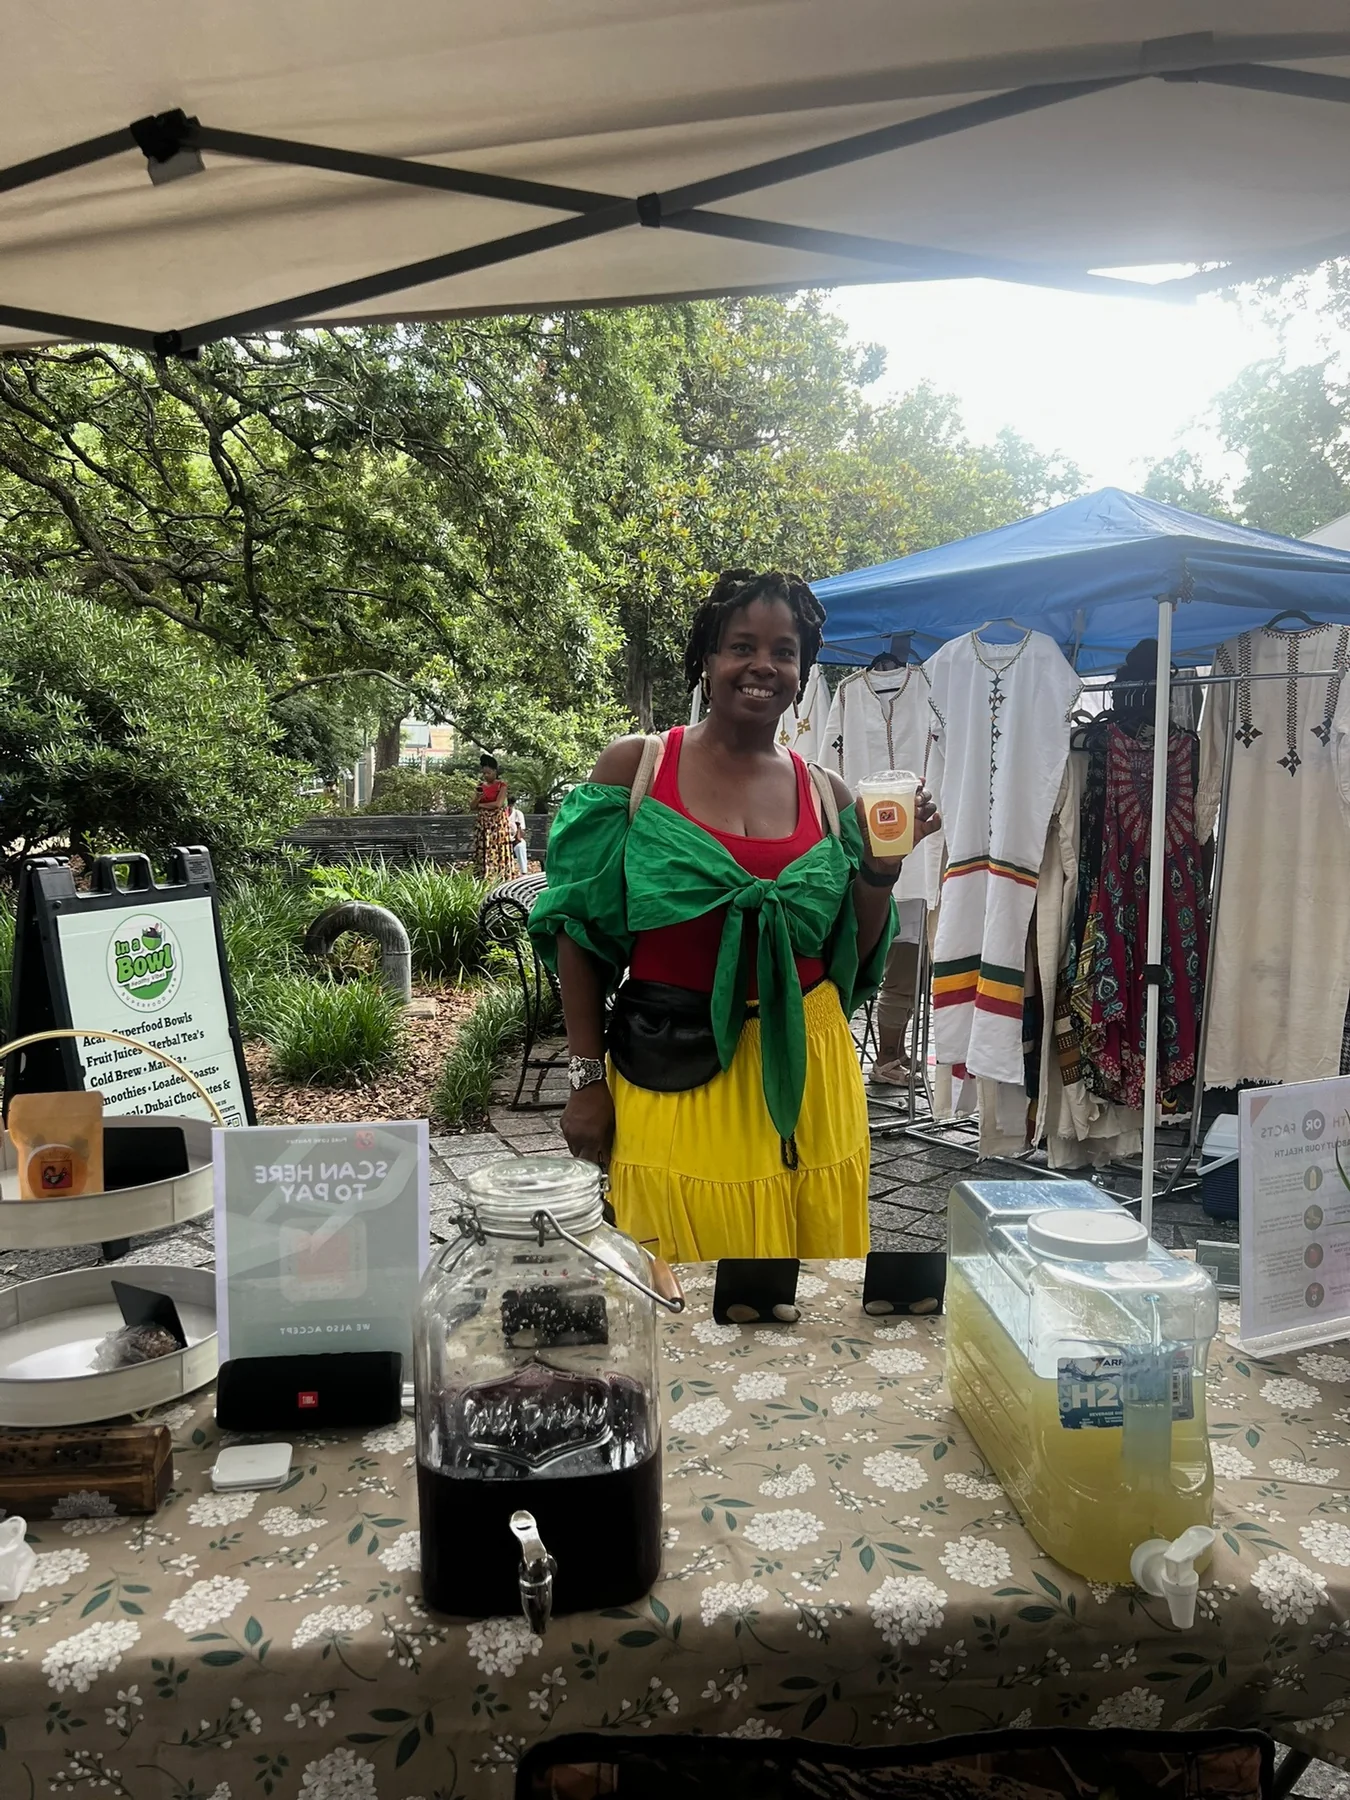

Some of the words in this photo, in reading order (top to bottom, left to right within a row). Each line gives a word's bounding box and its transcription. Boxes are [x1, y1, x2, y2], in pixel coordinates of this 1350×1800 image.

[115, 940, 130, 956] In
[131, 938, 141, 952] a
[115, 943, 173, 983] Bowl
[121, 992, 166, 1008] SUPERFOOD
[164, 1012, 193, 1027] Bowls
[86, 1051, 112, 1067] Fruit
[113, 1047, 143, 1062] Juices
[90, 1071, 114, 1088] Cold
[115, 1067, 142, 1081] Brew
[102, 1086, 147, 1107] moothies
[189, 1065, 217, 1079] oasts
[144, 1095, 174, 1115] Dubai
[173, 1083, 222, 1105] Choctes
[222, 1079, 231, 1090] &
[302, 1395, 316, 1405] JBL
